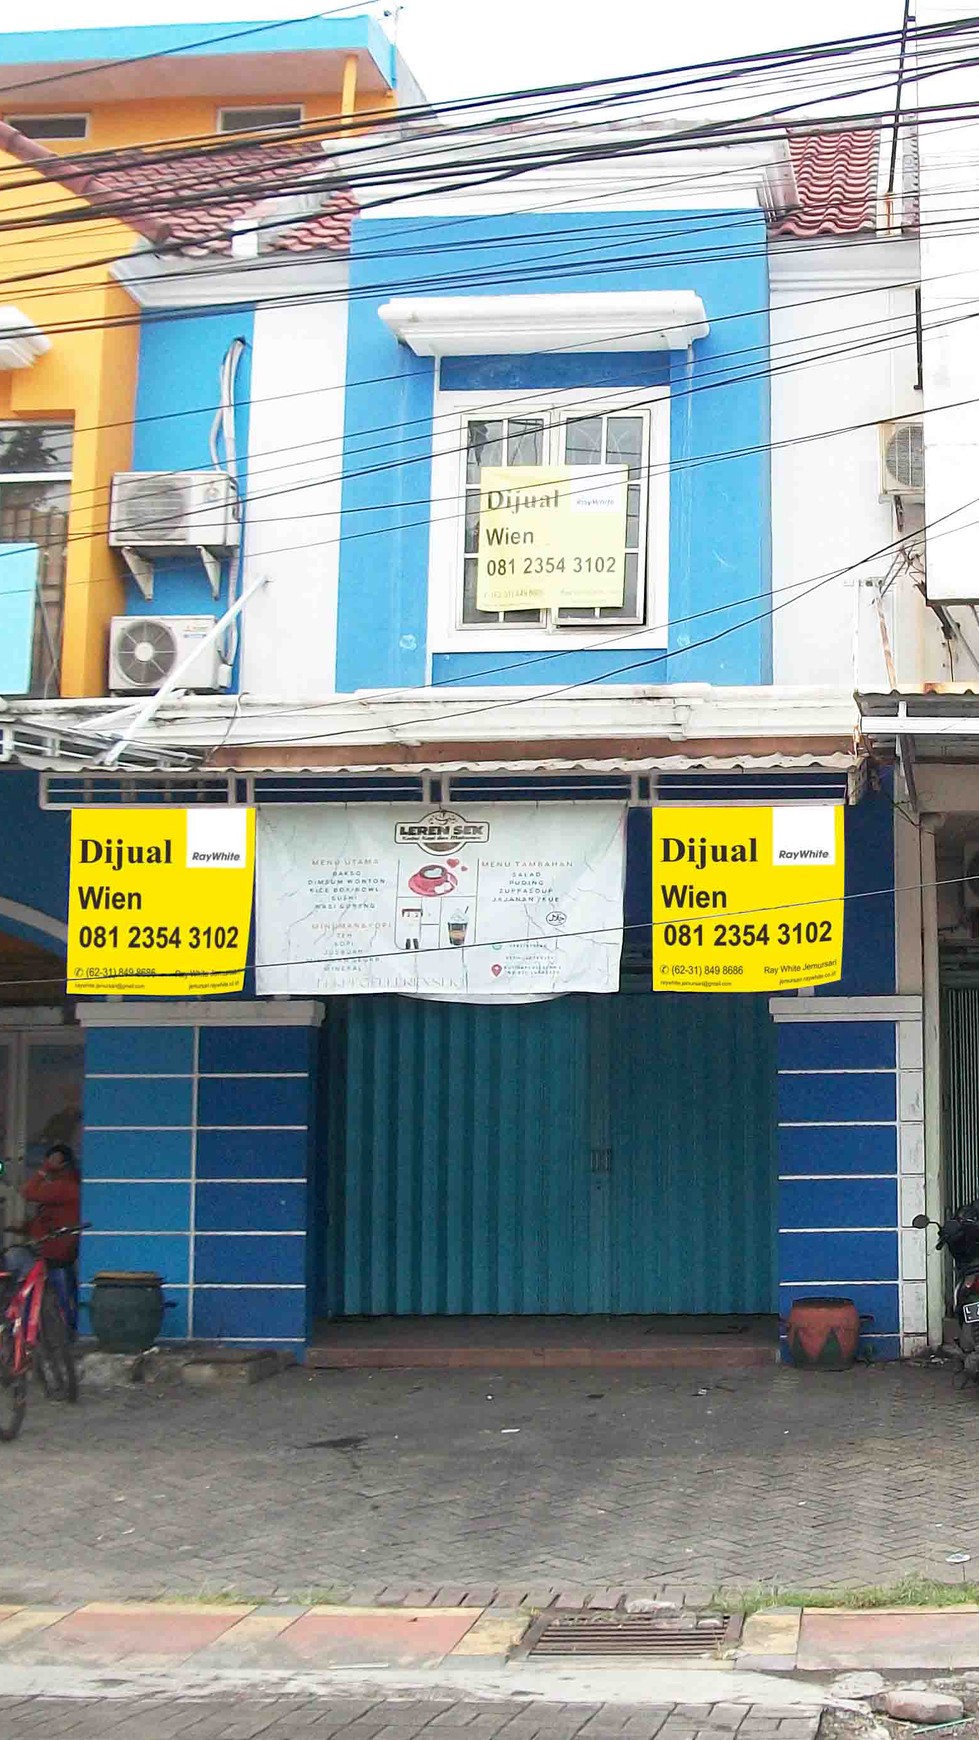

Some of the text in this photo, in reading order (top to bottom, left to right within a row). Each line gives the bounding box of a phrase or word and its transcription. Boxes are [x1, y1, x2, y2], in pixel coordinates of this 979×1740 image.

[487, 489, 559, 514] Dijual
[486, 527, 534, 546] Wien
[487, 556, 616, 576] 081 2354 3102
[400, 825, 484, 835] LEREN SEK
[78, 838, 173, 871] Dijual
[192, 851, 241, 862] RayWhite
[660, 837, 758, 870] Dijual
[778, 849, 829, 859] RayWhite
[78, 886, 142, 910] Wien
[661, 884, 727, 909] Wien
[79, 926, 239, 949] 081 2354 3102
[664, 920, 832, 946] 081 2354 3102
[86, 967, 116, 978] (62-31)
[671, 965, 744, 977] (62-31) 849 8686
[764, 959, 837, 976] Ray White Jemursari
